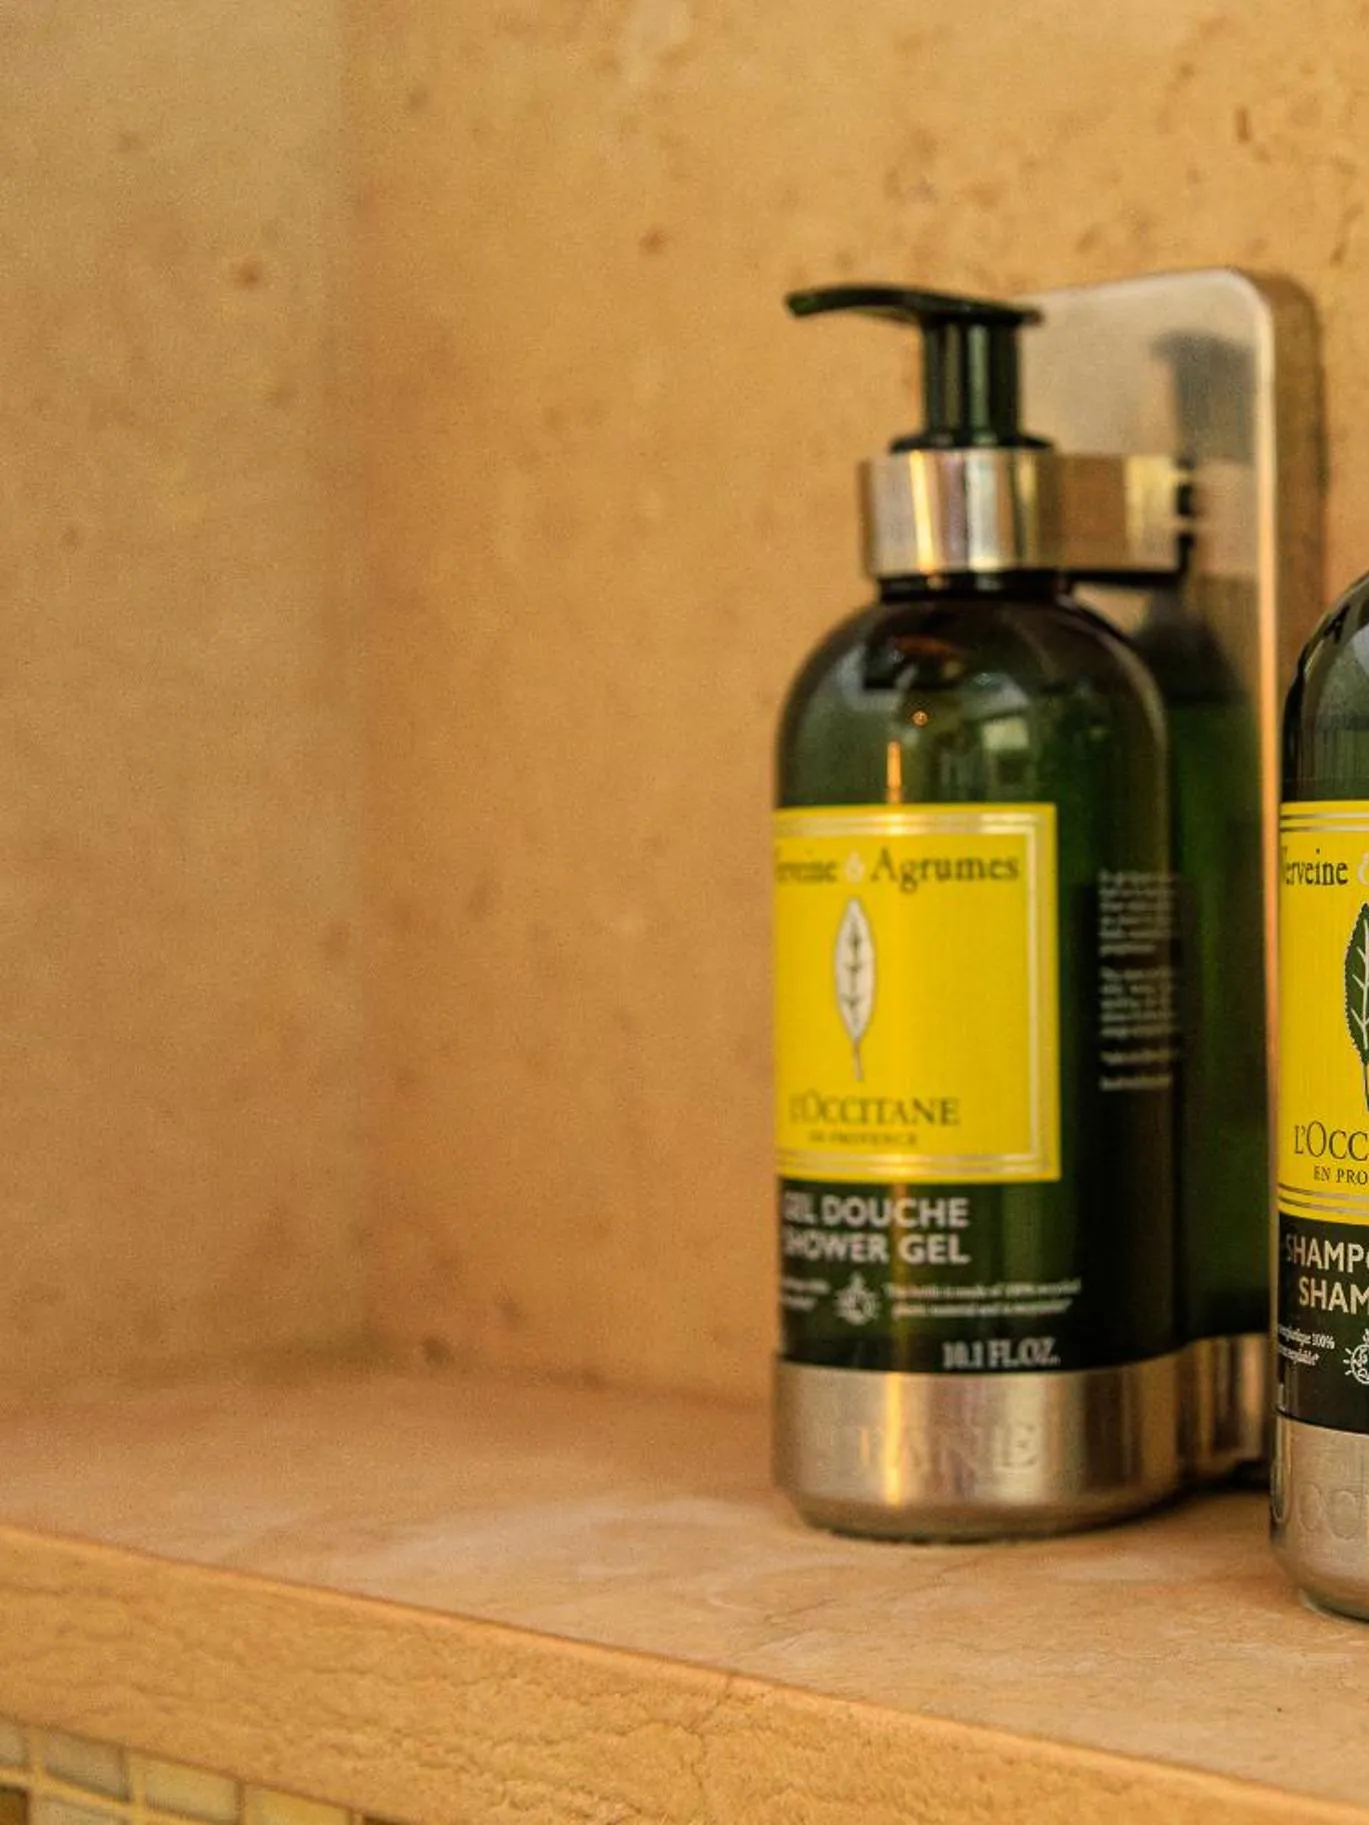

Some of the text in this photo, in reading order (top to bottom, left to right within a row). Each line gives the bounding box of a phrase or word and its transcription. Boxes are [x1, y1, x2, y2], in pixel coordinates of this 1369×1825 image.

[870, 846, 1019, 894] Agrumes
[1314, 1165, 1330, 1181] EN
[821, 1195, 970, 1228] DOUCHE
[899, 1234, 970, 1264] GEL
